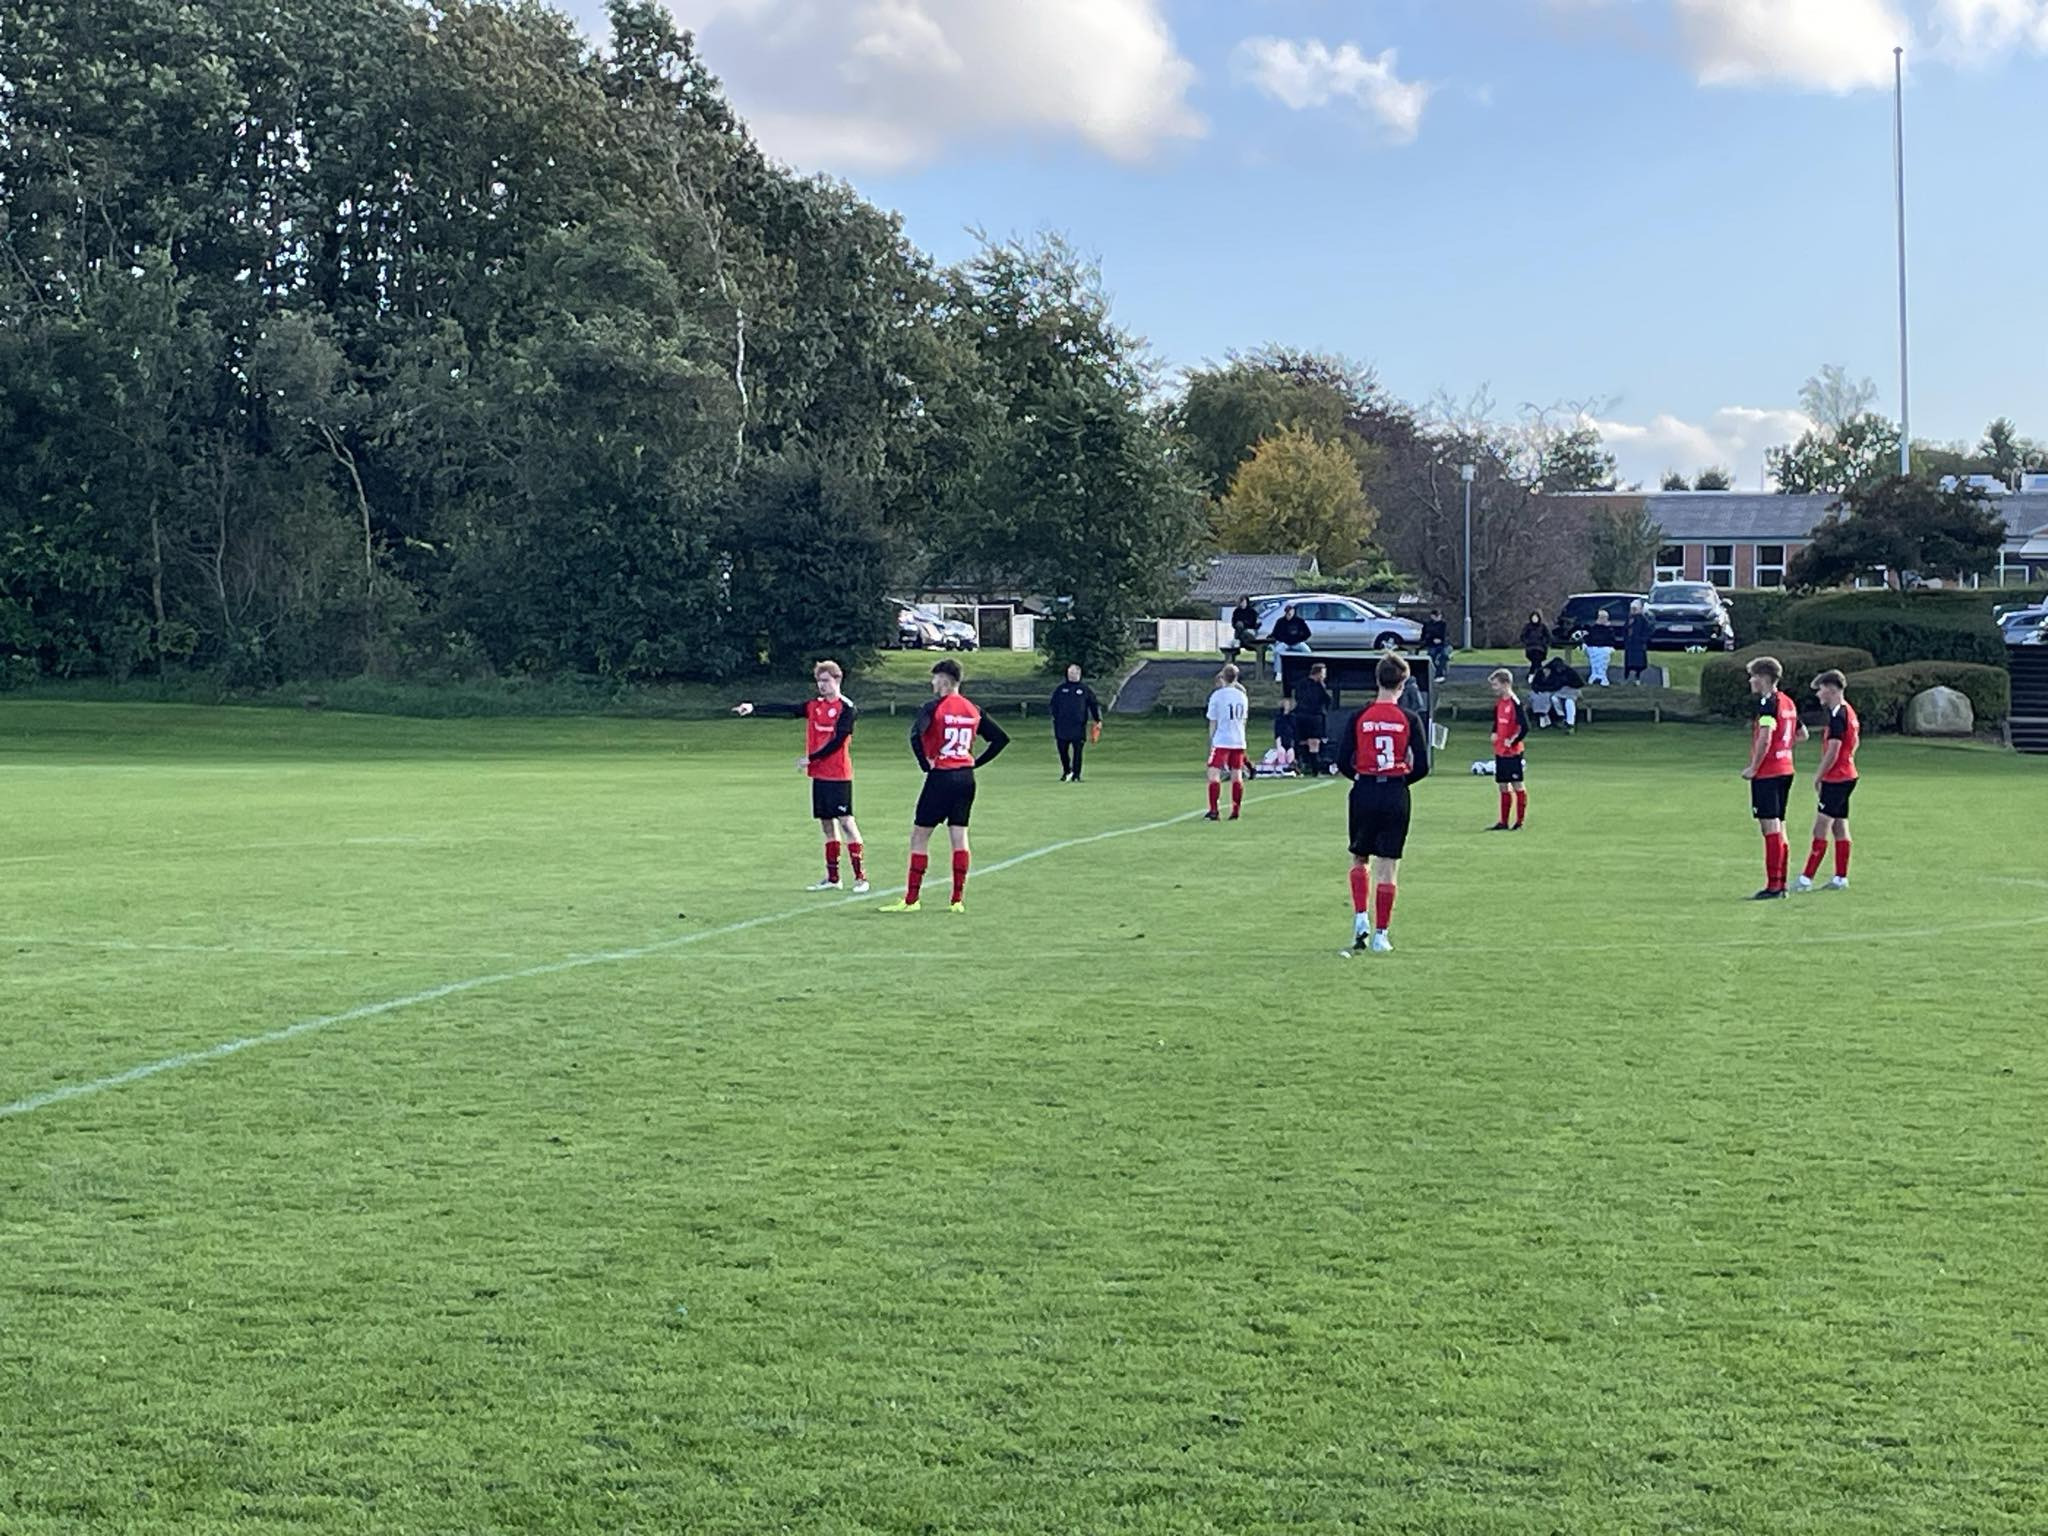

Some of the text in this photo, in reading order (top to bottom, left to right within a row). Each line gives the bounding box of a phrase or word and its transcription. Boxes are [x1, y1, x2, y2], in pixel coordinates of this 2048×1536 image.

[1228, 703, 1244, 720] 10
[940, 727, 973, 756] 29
[1375, 735, 1395, 770] 3
